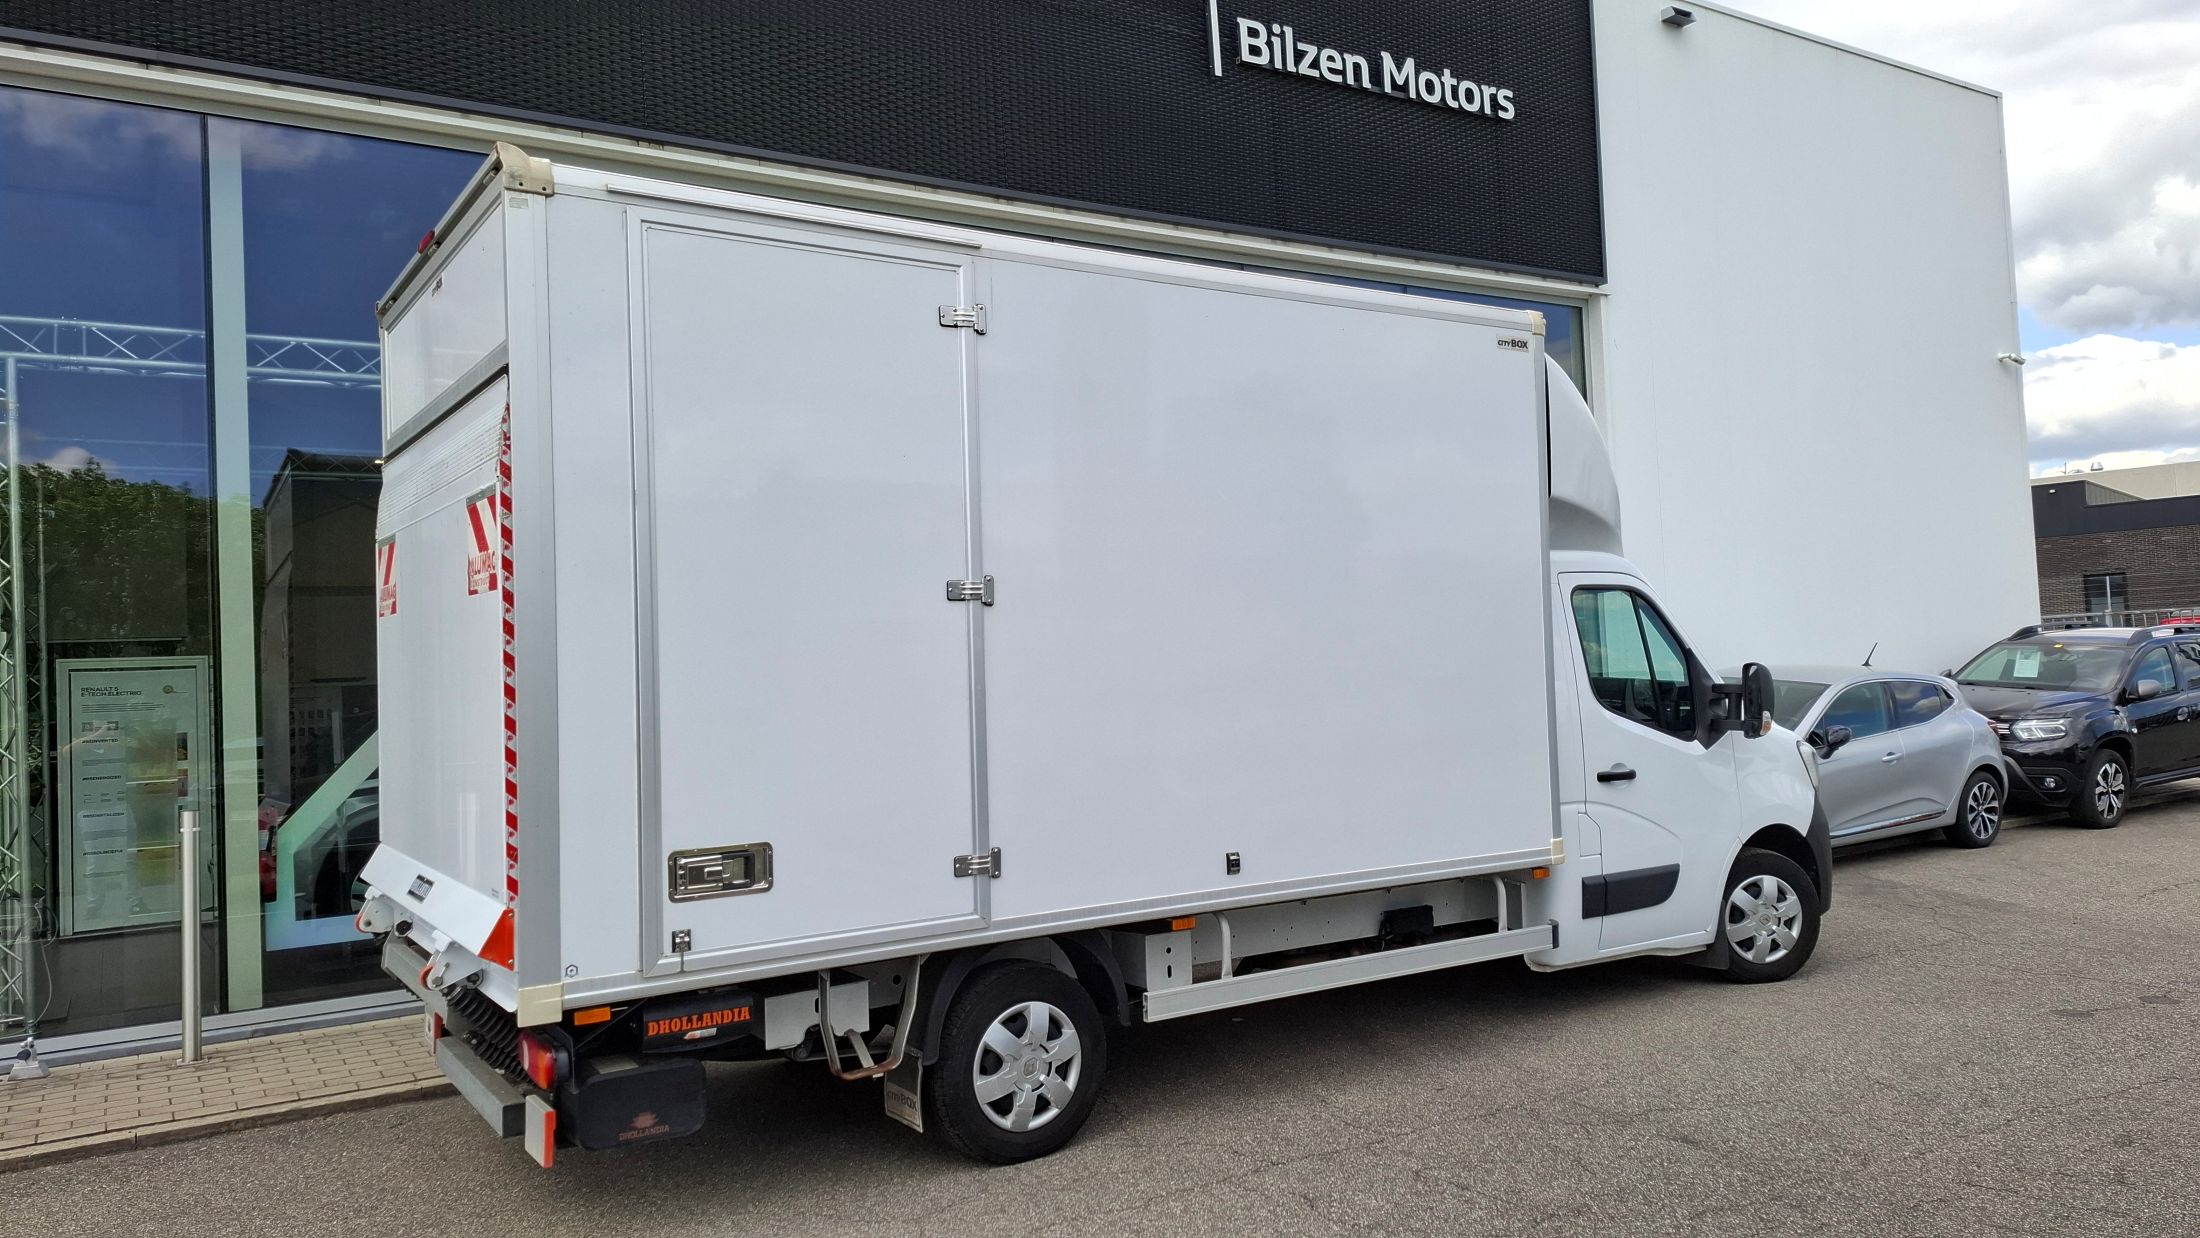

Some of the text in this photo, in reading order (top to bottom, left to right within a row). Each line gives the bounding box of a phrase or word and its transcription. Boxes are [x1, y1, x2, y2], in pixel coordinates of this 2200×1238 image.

[1236, 16, 1515, 120] Bilzen Motors
[647, 1006, 751, 1037] DHOLLANDIA
[618, 1124, 670, 1141] DHOLLANDIA
